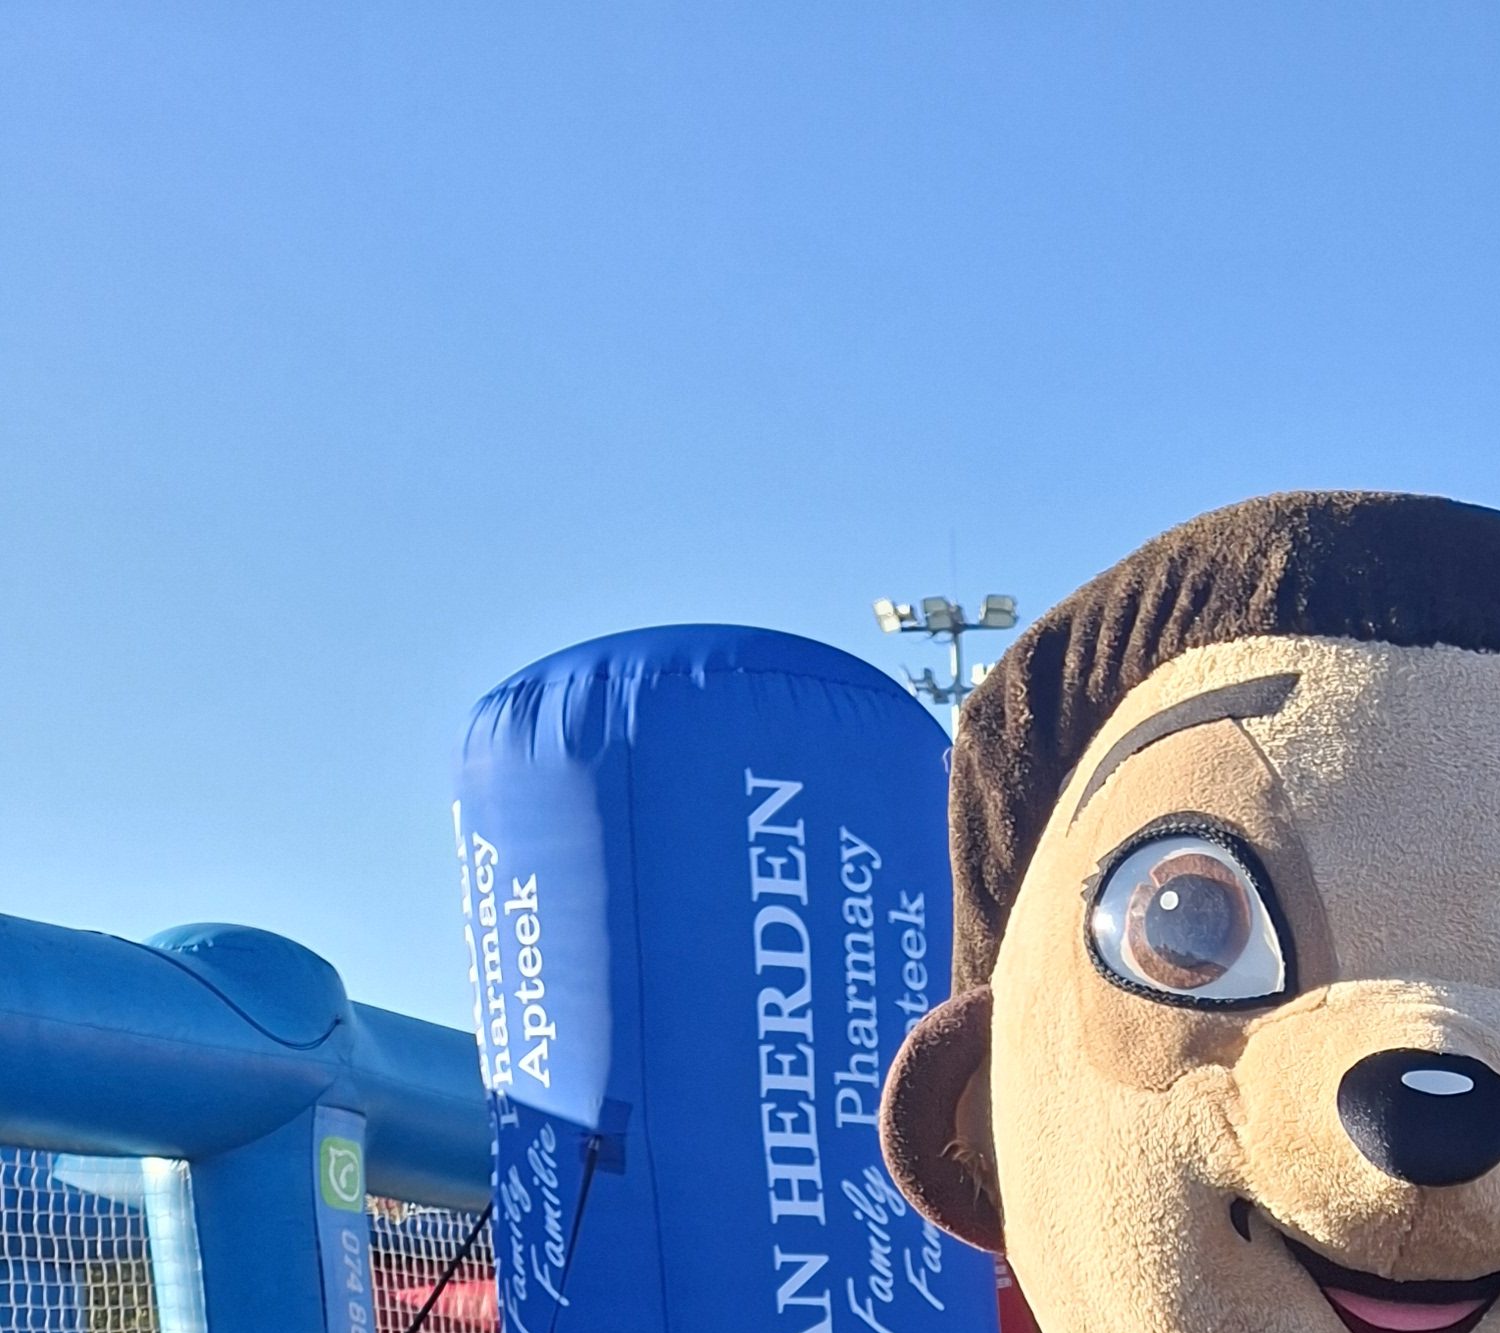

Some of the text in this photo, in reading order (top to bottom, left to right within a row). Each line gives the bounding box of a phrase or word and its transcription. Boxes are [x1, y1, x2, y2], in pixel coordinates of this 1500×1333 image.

[505, 872, 571, 1307] Familie Apteek
[744, 766, 826, 1226] HEERDEN
[834, 825, 882, 1131] Pharmacy
[889, 888, 929, 1036] teek
